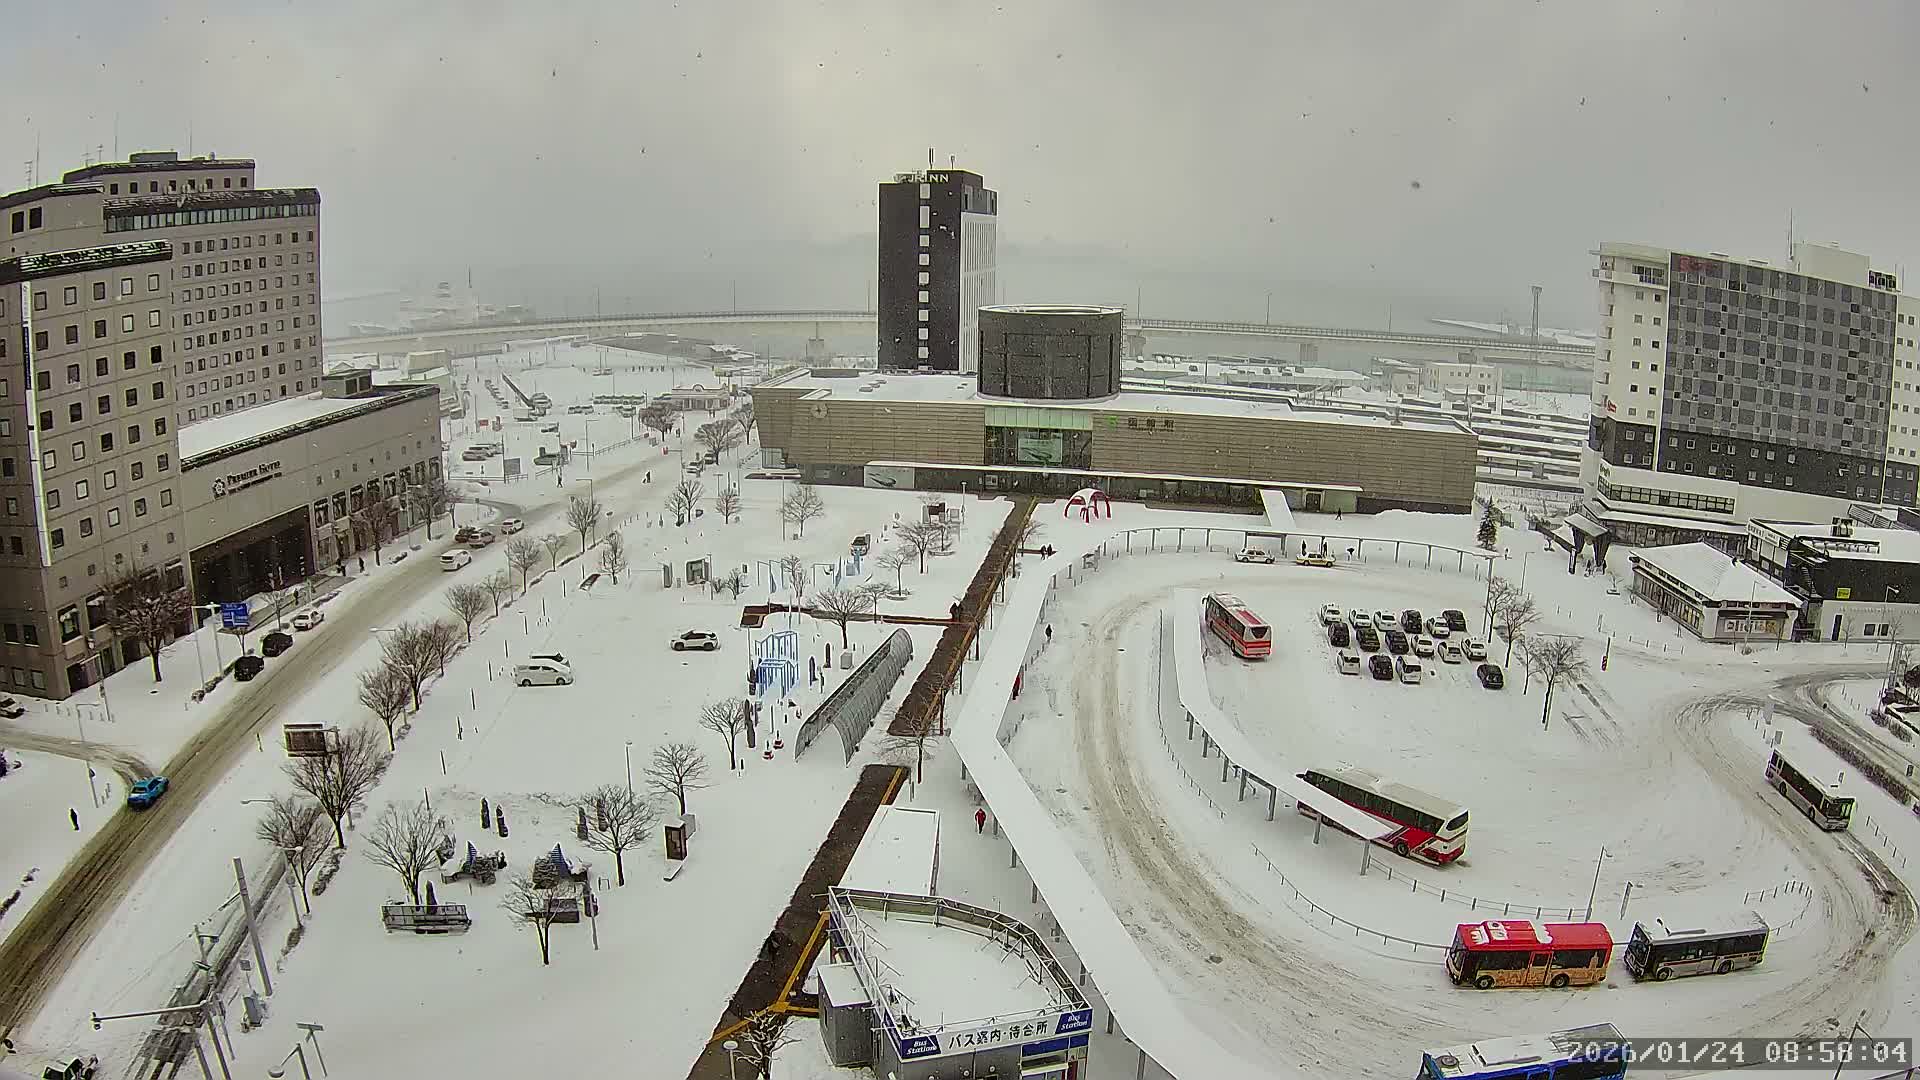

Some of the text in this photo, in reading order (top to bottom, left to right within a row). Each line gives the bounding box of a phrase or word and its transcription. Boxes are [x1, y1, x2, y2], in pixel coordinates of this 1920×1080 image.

[925, 173, 949, 183] INN
[1060, 1020, 1088, 1031] Station
[913, 1040, 928, 1048] Bus
[906, 1045, 938, 1056] Station
